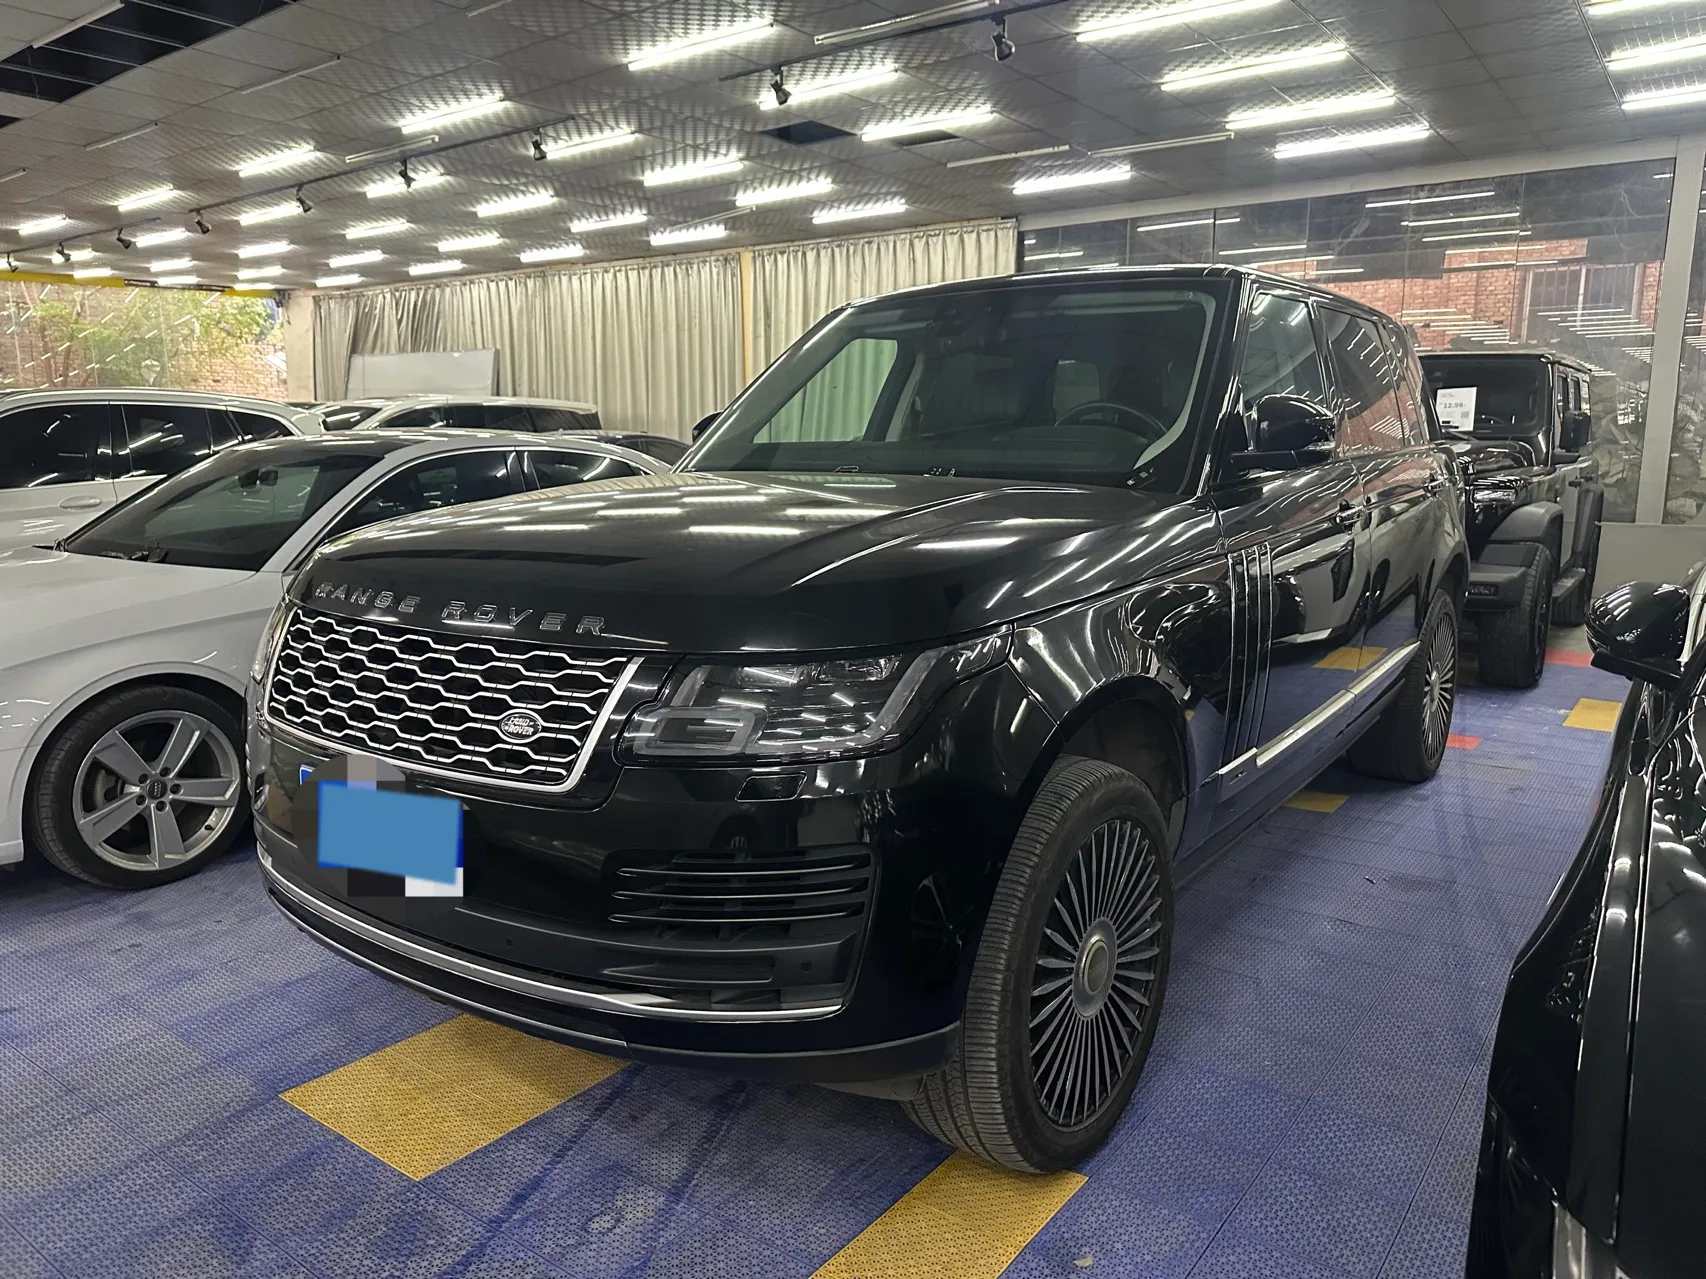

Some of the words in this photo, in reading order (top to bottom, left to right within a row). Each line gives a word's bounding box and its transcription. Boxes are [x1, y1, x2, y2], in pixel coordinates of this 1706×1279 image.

[314, 581, 421, 613] RANGE
[441, 600, 605, 636] ROVER
[509, 717, 530, 726] LAND
[507, 724, 534, 736] ROVER
